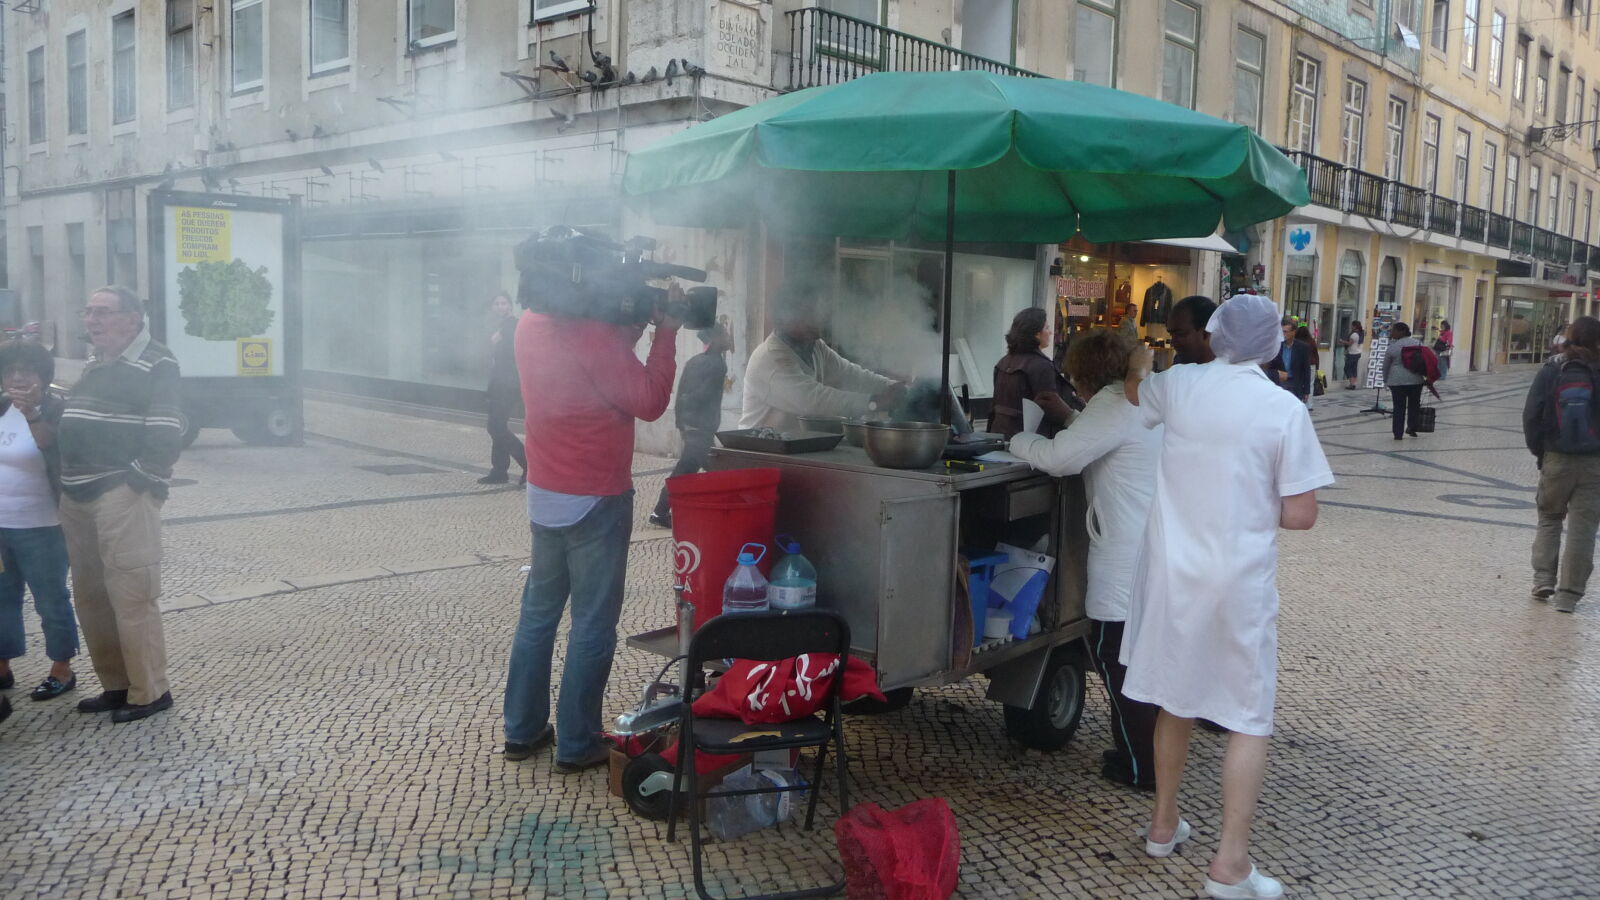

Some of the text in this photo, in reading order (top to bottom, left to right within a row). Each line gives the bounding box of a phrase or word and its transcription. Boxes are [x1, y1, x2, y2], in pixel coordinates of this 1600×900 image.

[192, 211, 225, 220] PESSOAS
[198, 220, 226, 228] QUEREM
[182, 227, 219, 235] PRODUTOS
[182, 243, 218, 251] COMPRAM
